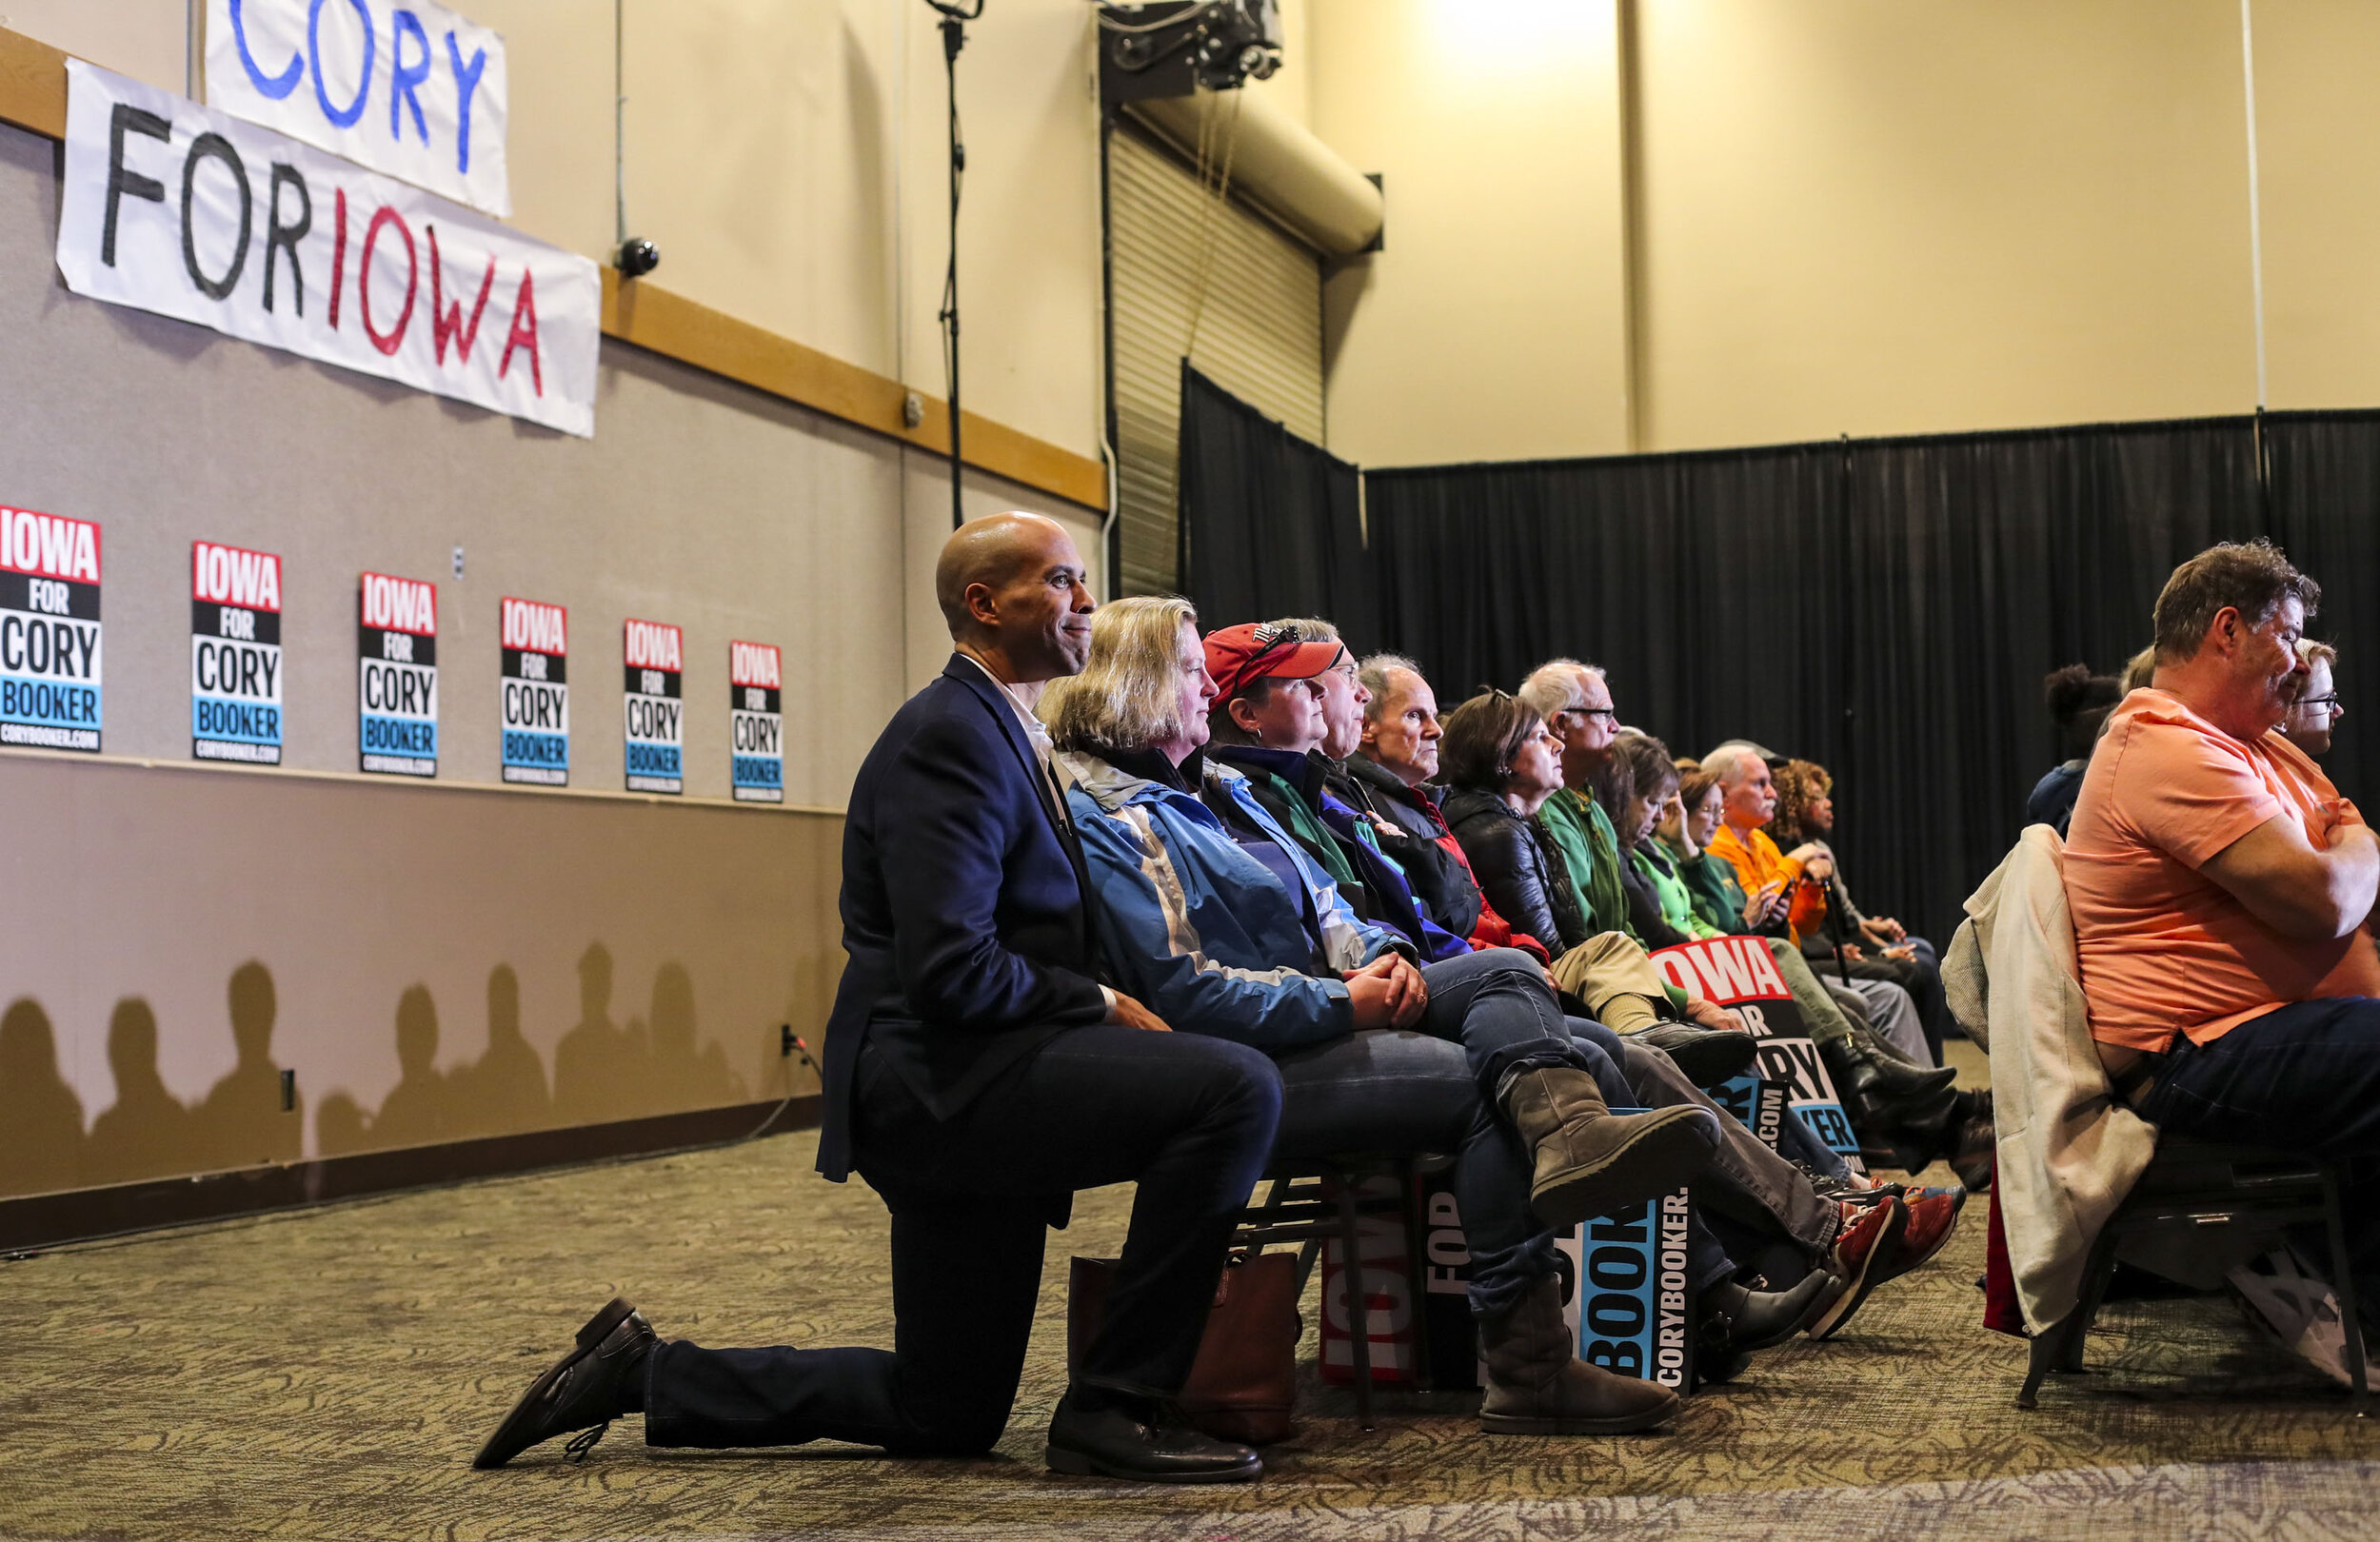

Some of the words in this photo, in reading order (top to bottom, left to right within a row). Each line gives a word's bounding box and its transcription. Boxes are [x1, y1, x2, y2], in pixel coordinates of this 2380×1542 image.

[228, 0, 486, 174] CORY
[101, 102, 311, 318] FOR
[327, 188, 542, 398] IOWA
[0, 508, 98, 582] IOWA
[29, 578, 69, 615] FOR
[196, 544, 280, 609] IOWA
[220, 606, 255, 641] FOR
[364, 574, 434, 633] IOWA
[504, 599, 565, 653] IOWA
[2, 616, 97, 679] CORY
[383, 632, 413, 662] FOR
[521, 651, 547, 681] FOR
[626, 621, 681, 670] IOWA
[732, 642, 779, 686] IOWA
[198, 642, 278, 698] CORY
[367, 664, 433, 715] CORY
[641, 669, 665, 696] FOR
[4, 680, 96, 722] BOOKER
[199, 701, 278, 739] BOOKER
[506, 683, 564, 728] CORY
[629, 699, 679, 741] CORY
[367, 719, 433, 752] BOOKER
[506, 733, 565, 762] BOOKER
[735, 715, 780, 753] CORY
[629, 744, 680, 773] BOOKER
[1650, 939, 1788, 1000] OWA
[1757, 1043, 1829, 1101] RY
[1587, 1204, 1648, 1379] BOOK
[1657, 1187, 1689, 1388] CORYBOOKER.
